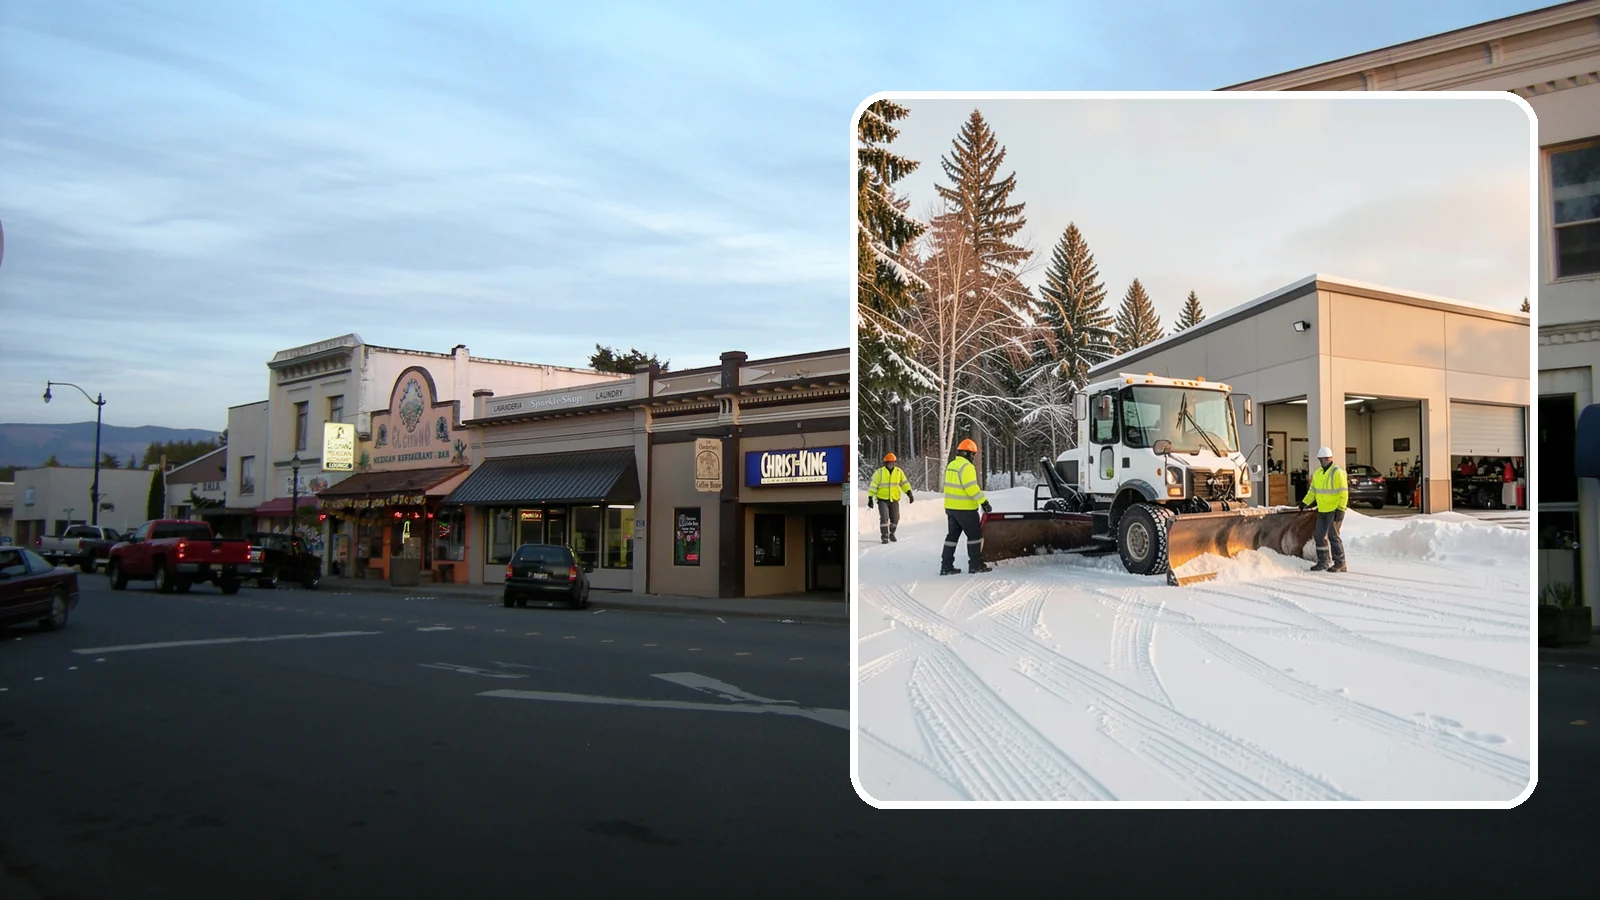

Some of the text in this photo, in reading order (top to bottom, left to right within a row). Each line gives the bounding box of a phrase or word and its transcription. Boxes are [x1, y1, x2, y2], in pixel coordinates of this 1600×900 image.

[562, 394, 582, 405] Shop
[595, 388, 624, 400] LAUNDRY
[493, 402, 522, 412] LAVANDERIA
[397, 451, 434, 462] RESTAURANT
[438, 449, 450, 459] BAR
